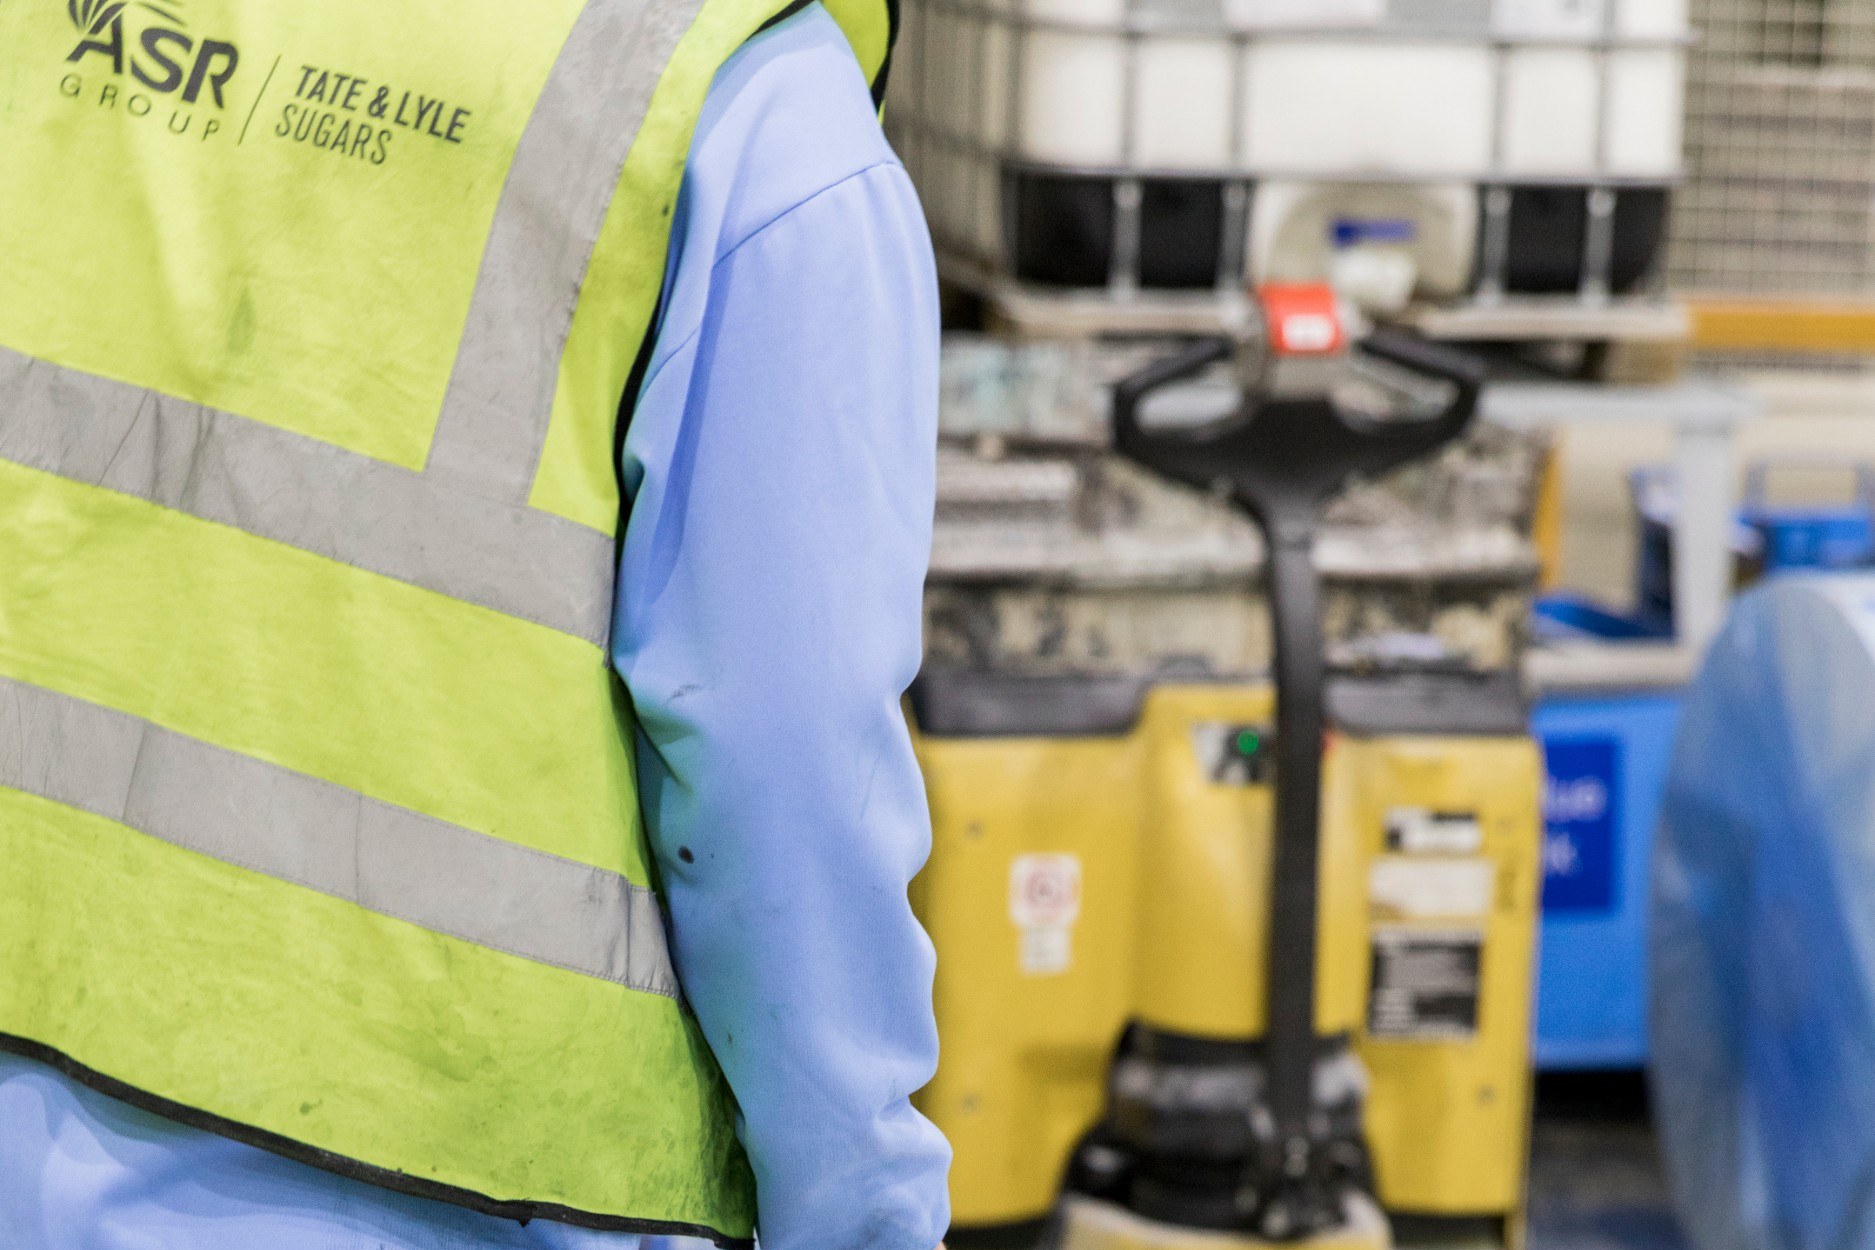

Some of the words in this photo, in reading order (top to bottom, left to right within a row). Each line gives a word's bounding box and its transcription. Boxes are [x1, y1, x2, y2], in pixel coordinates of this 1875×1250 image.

[65, 4, 239, 110] ASR
[59, 73, 220, 141] GROUP
[275, 104, 392, 165] SUGARS
[296, 65, 366, 112] TATE
[368, 86, 390, 119] &
[393, 91, 471, 143] LYLE
